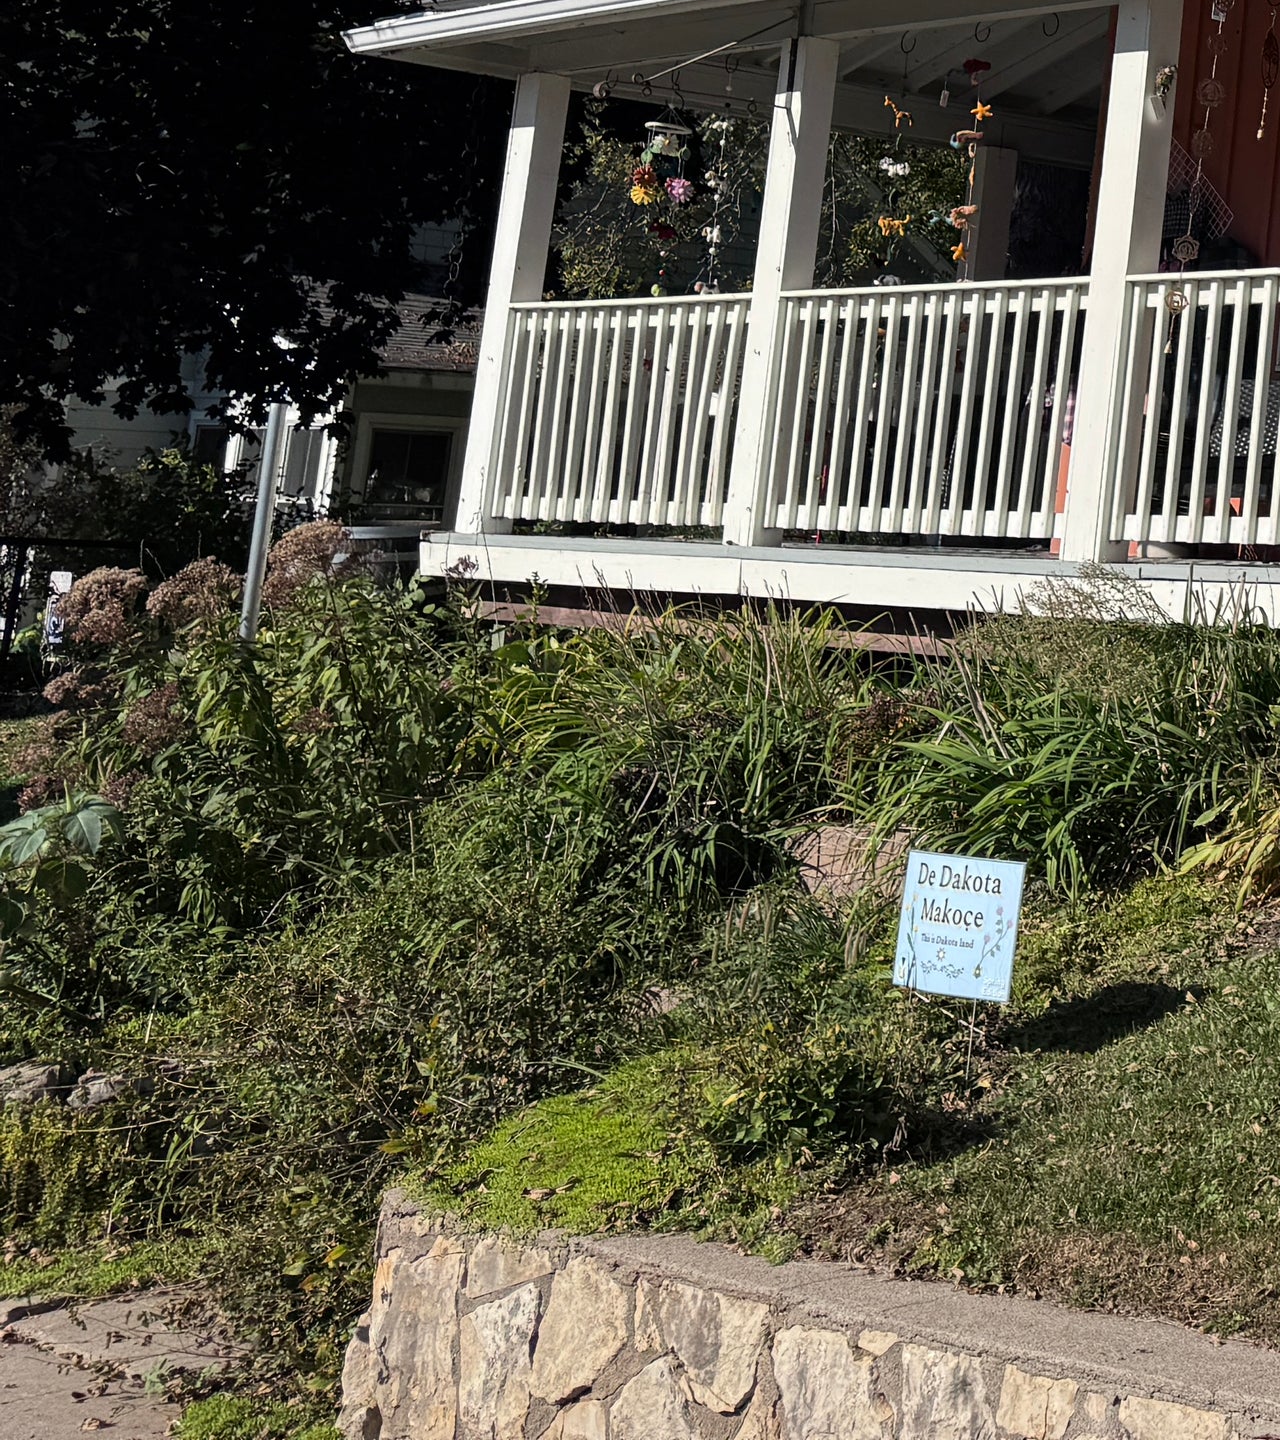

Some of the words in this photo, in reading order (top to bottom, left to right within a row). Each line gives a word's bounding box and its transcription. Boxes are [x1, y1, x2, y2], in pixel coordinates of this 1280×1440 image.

[917, 862, 936, 886] De
[939, 865, 1002, 895] Dakota
[936, 935, 958, 947] Dakota
[959, 937, 974, 949] land
